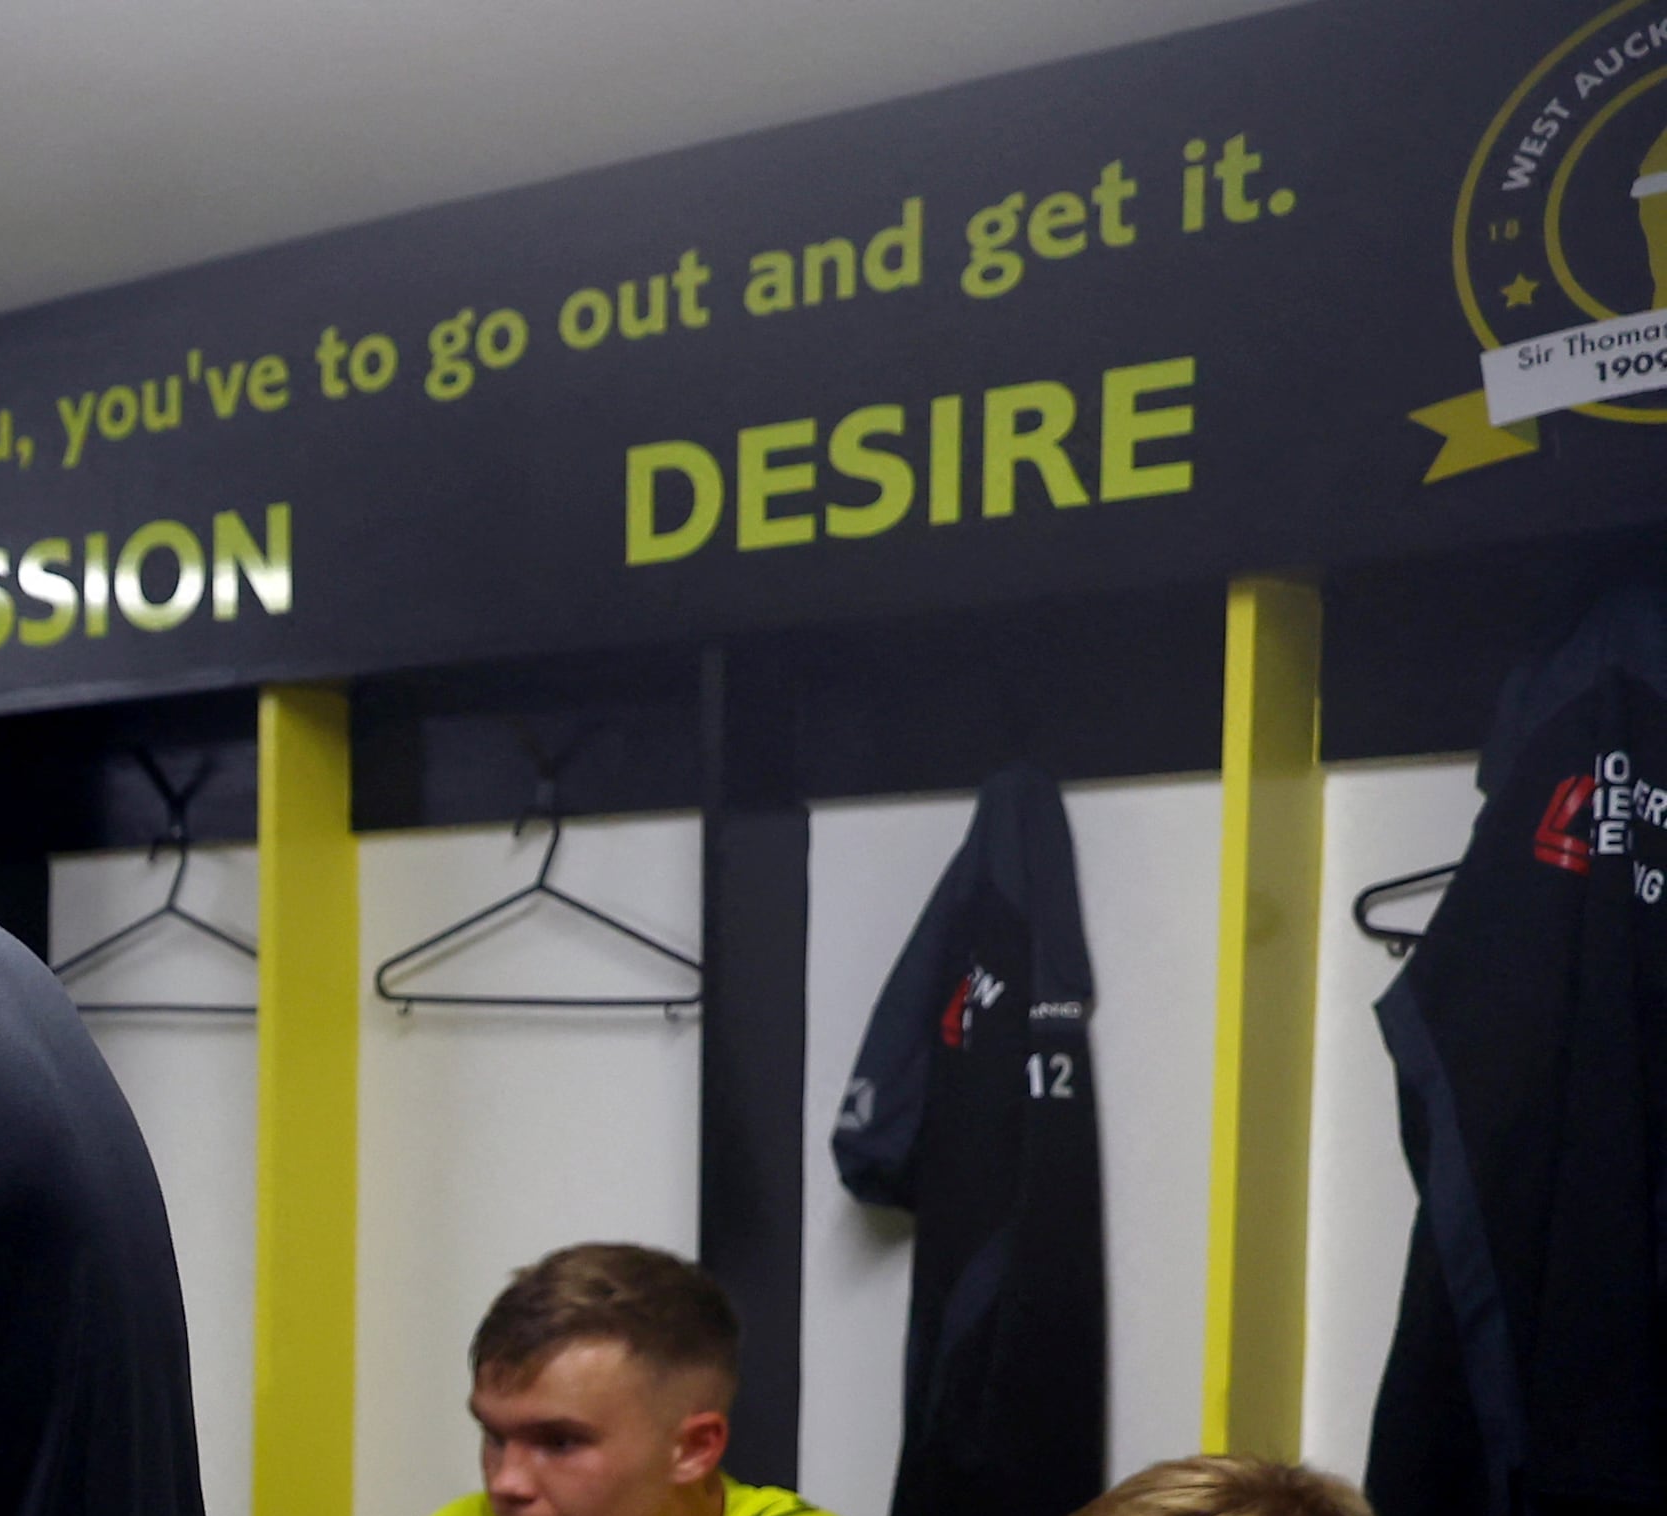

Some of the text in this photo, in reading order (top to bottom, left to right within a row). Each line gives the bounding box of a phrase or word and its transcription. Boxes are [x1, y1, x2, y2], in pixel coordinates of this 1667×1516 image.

[1501, 98, 1570, 191] WEST
[60, 352, 287, 467] you've
[317, 330, 397, 397] to
[425, 311, 528, 400] go
[560, 253, 709, 348] out
[745, 199, 923, 314] and
[963, 166, 1136, 297] get
[1184, 135, 1295, 231] it.
[1518, 343, 1553, 371] Sir
[625, 356, 1197, 566] DESIRE
[1025, 1052, 1073, 1099] 12
